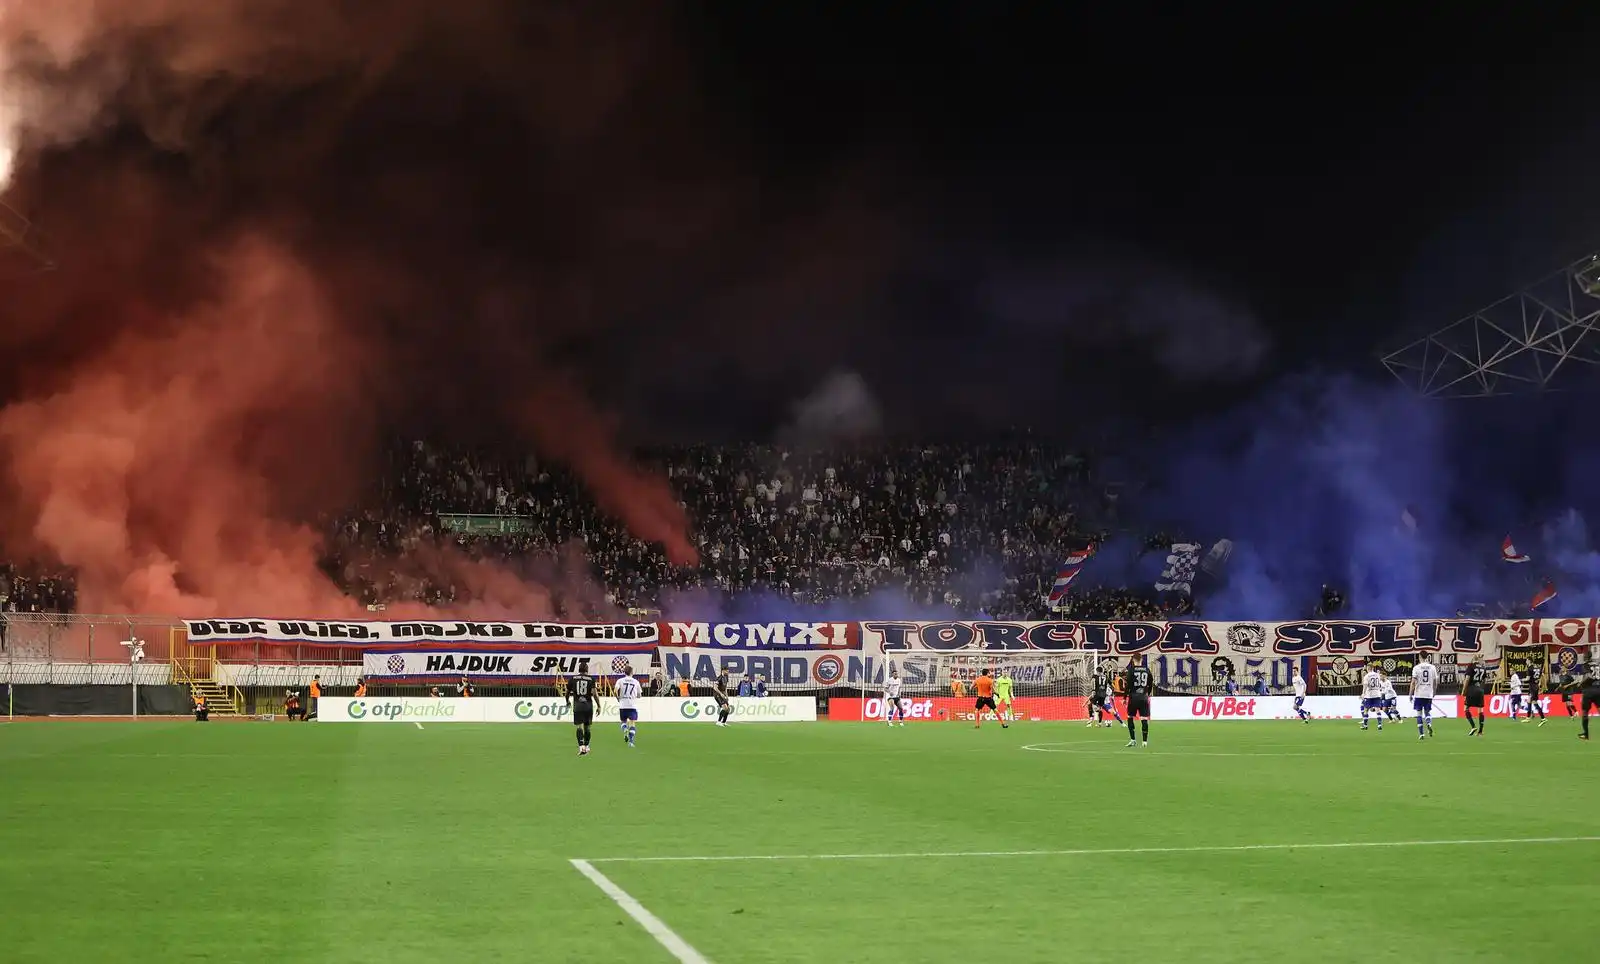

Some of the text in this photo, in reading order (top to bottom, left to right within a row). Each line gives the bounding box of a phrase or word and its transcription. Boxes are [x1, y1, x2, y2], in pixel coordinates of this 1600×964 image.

[668, 622, 848, 646] MCMXI
[865, 620, 1496, 654] TORCIDA SPLIT
[426, 655, 591, 673] HAJDUK SPLIT
[666, 653, 808, 684] NAPRID
[1134, 672, 1148, 687] 39
[1422, 670, 1429, 683] 9
[1473, 668, 1485, 682] 27
[576, 680, 588, 695] 18
[623, 683, 635, 695] 77
[1205, 684, 1227, 694] TORC
[372, 701, 455, 720] otpbanka
[538, 701, 621, 720] otpka
[1192, 696, 1256, 720] OlyBet
